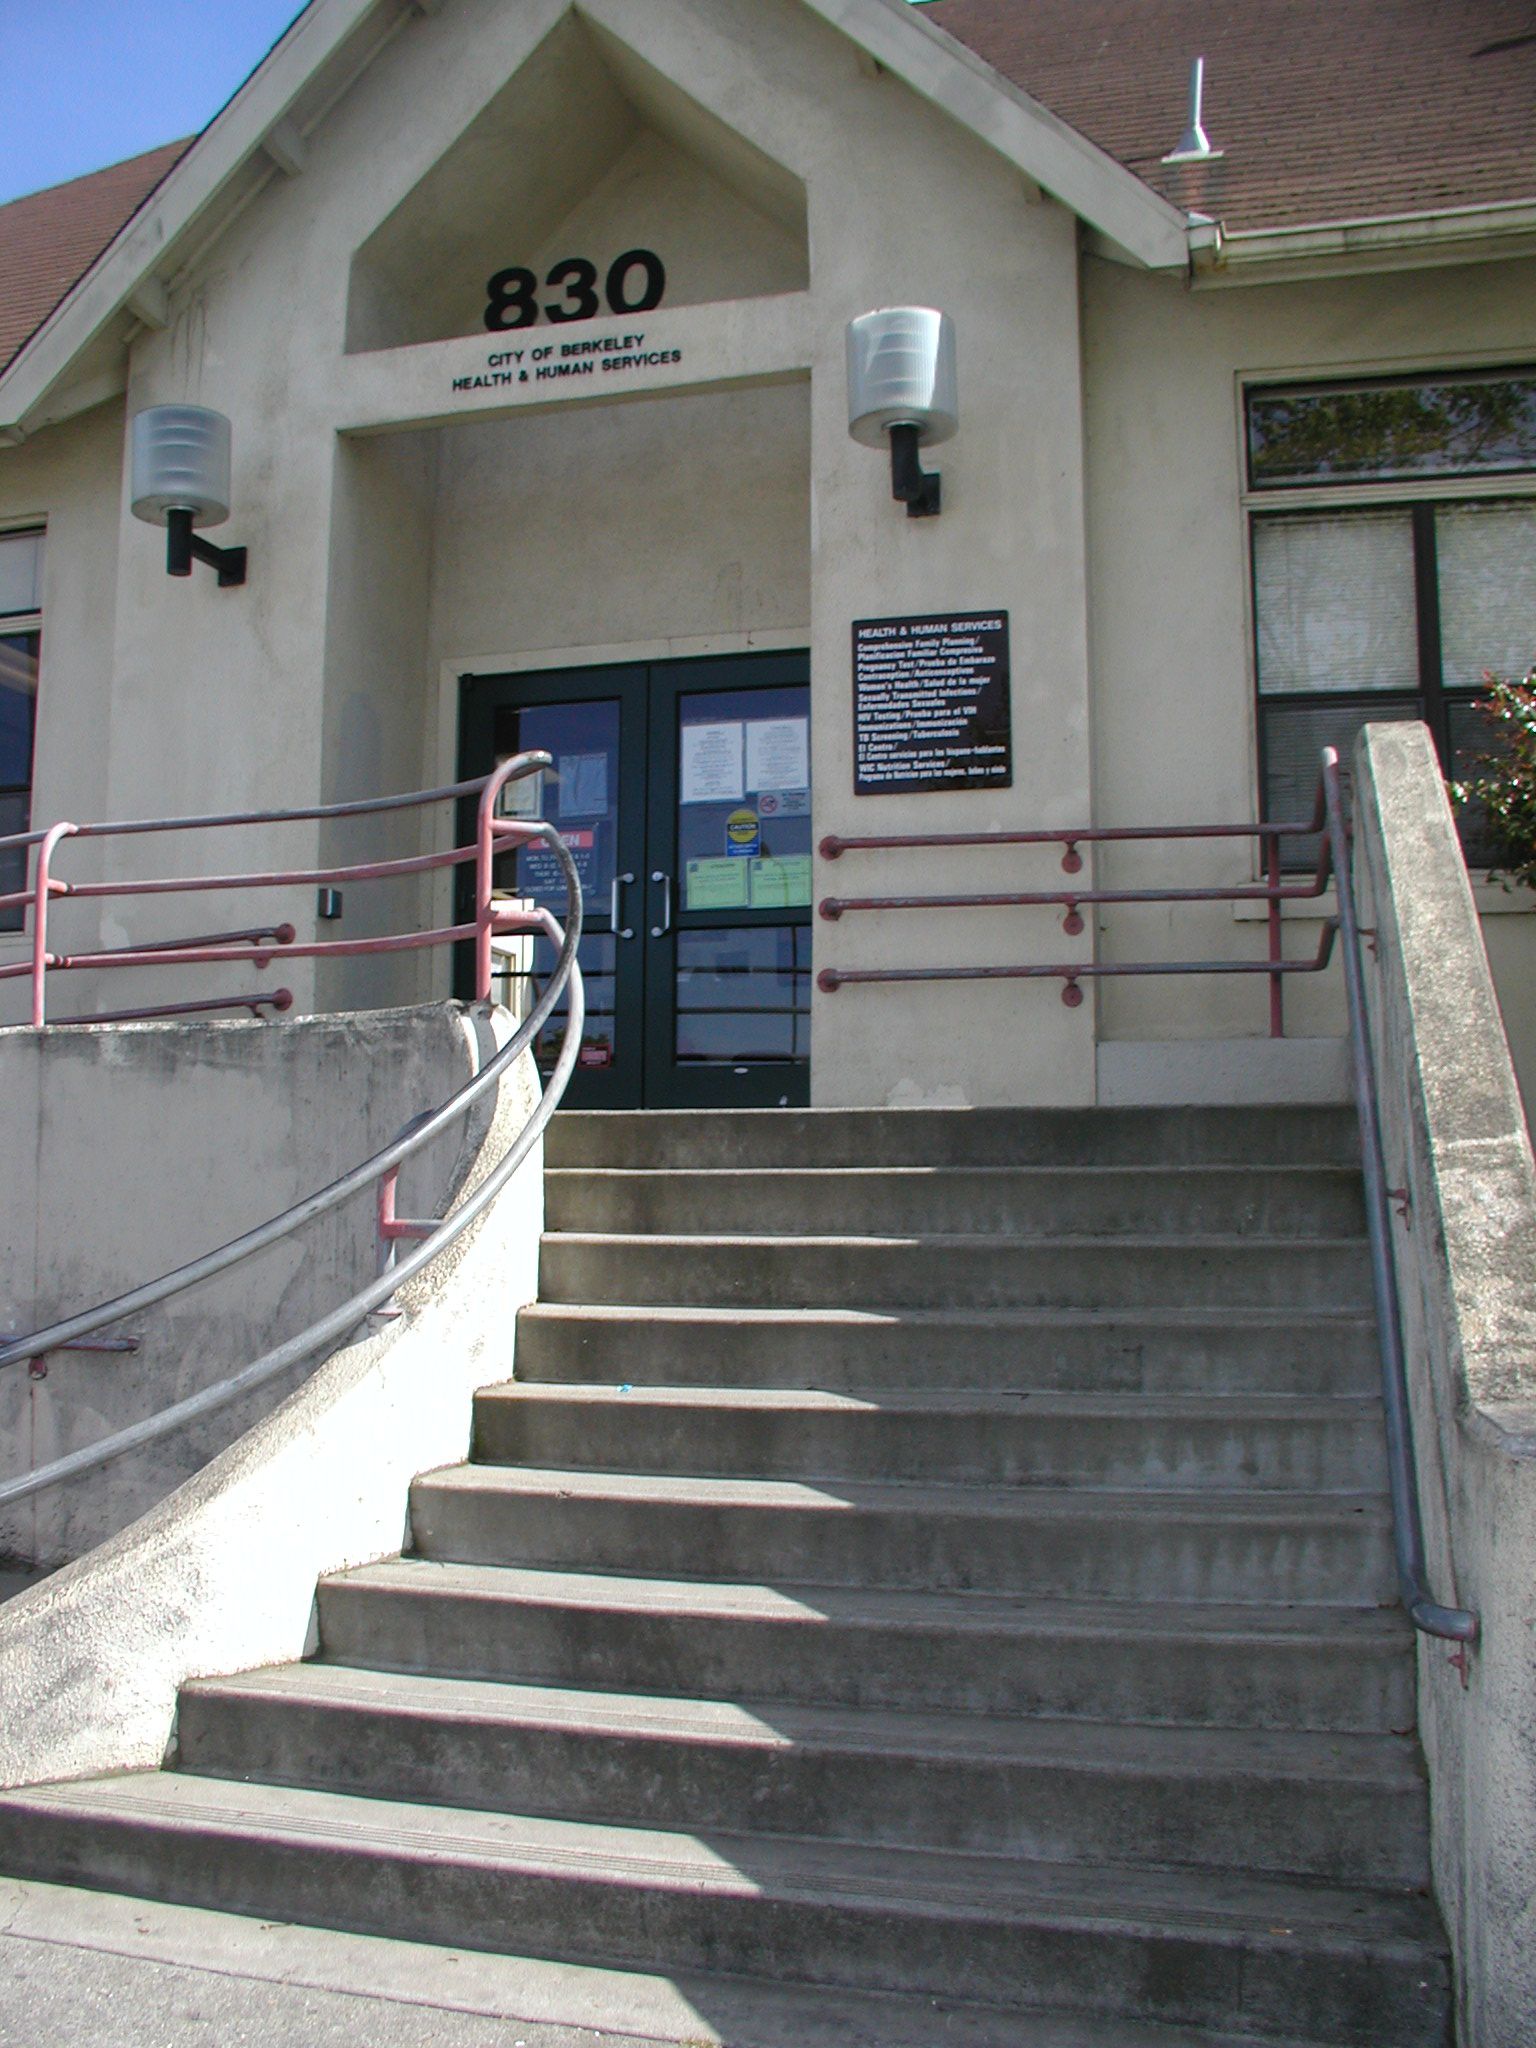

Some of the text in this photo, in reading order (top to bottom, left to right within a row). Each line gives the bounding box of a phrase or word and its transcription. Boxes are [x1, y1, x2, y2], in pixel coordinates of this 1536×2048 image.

[484, 248, 666, 332] 830
[488, 334, 645, 368] CITY OF BERKELEY
[452, 349, 682, 392] HEALTH & HUMAN SERVICES
[859, 620, 1002, 638] HEALTH & HUMAN SERVICES
[541, 834, 580, 848] OEN
